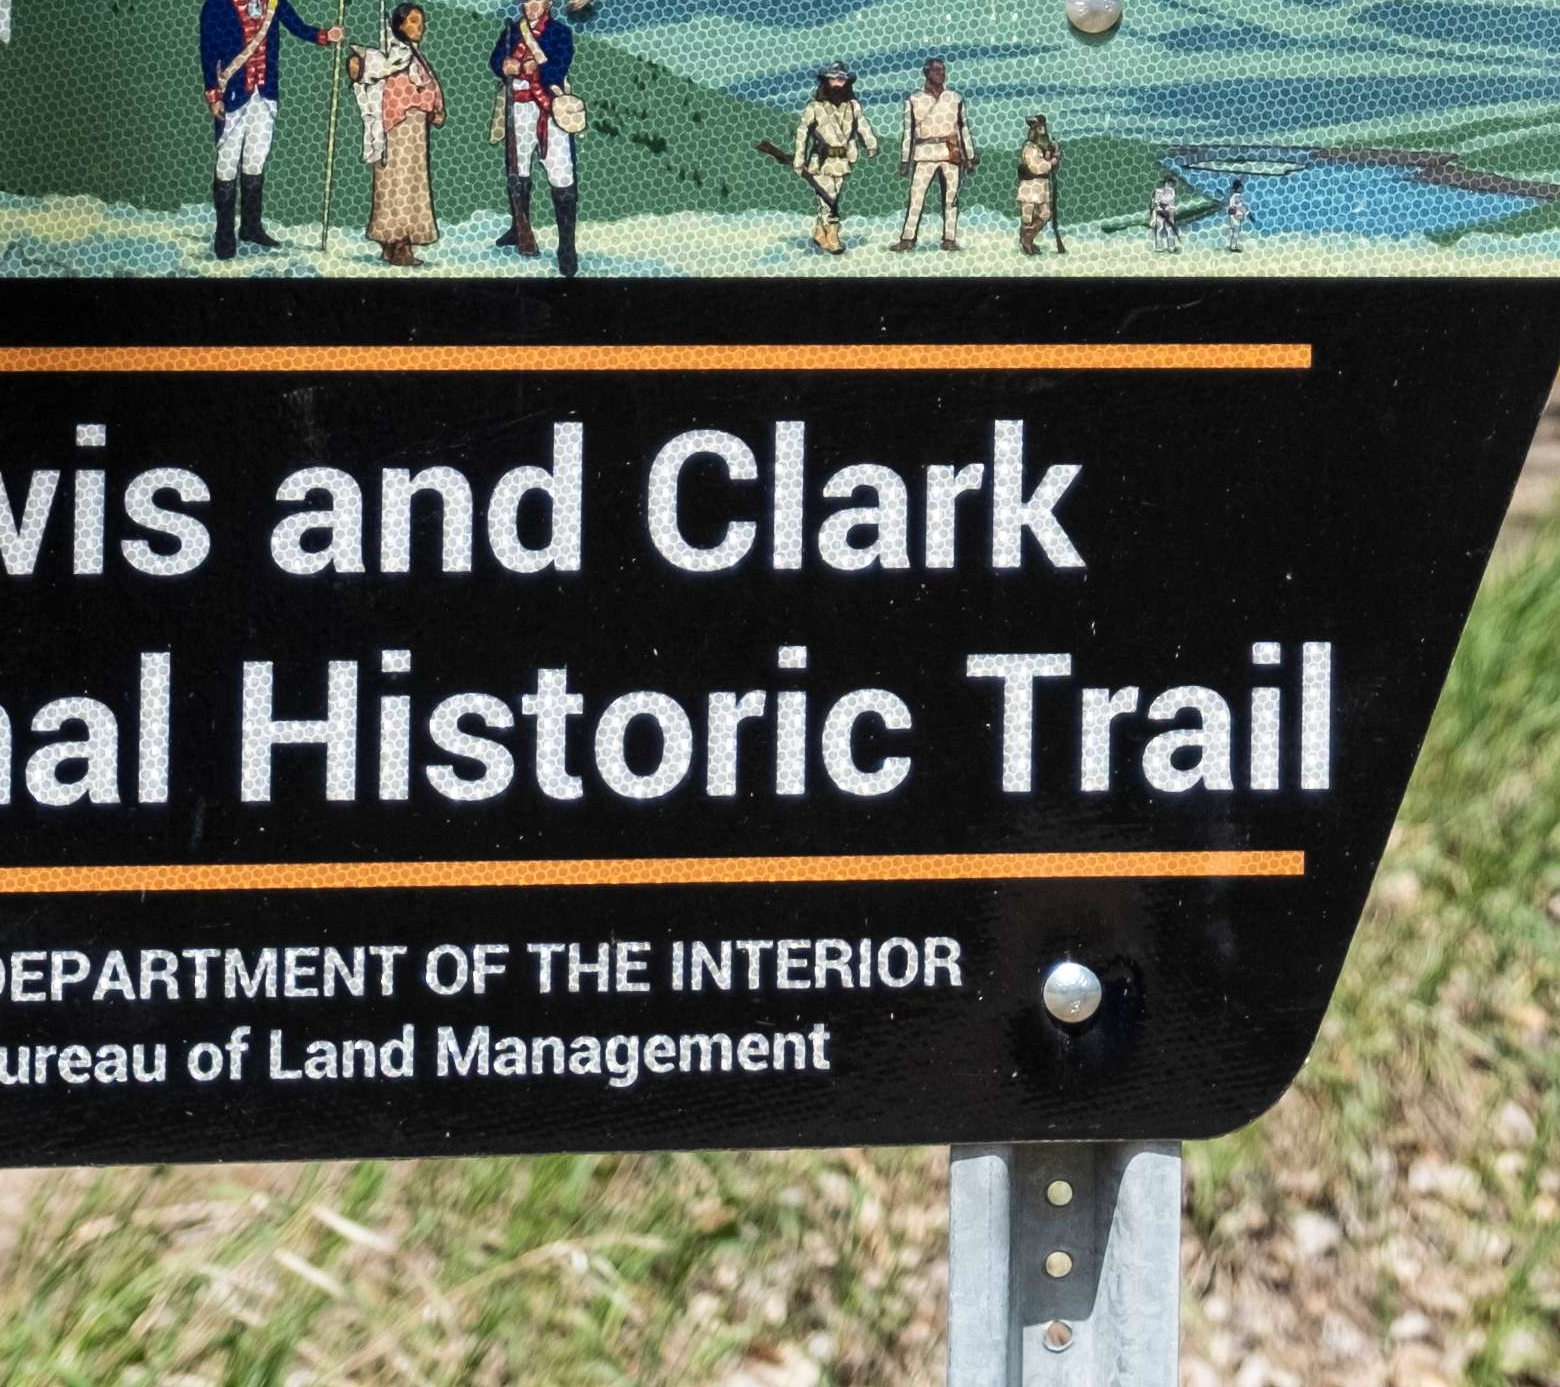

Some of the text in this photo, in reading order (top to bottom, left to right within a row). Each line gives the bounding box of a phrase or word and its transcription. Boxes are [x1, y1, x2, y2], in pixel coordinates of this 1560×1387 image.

[268, 420, 584, 577] and
[646, 418, 1087, 574] Clark
[239, 644, 914, 804] Historic
[964, 640, 1333, 795] Trail
[424, 943, 510, 996] OF
[526, 941, 653, 994] THE
[670, 935, 964, 992] INTERIOR
[186, 1025, 252, 1082] of
[268, 1023, 416, 1081] Land
[435, 1021, 832, 1089] Management
